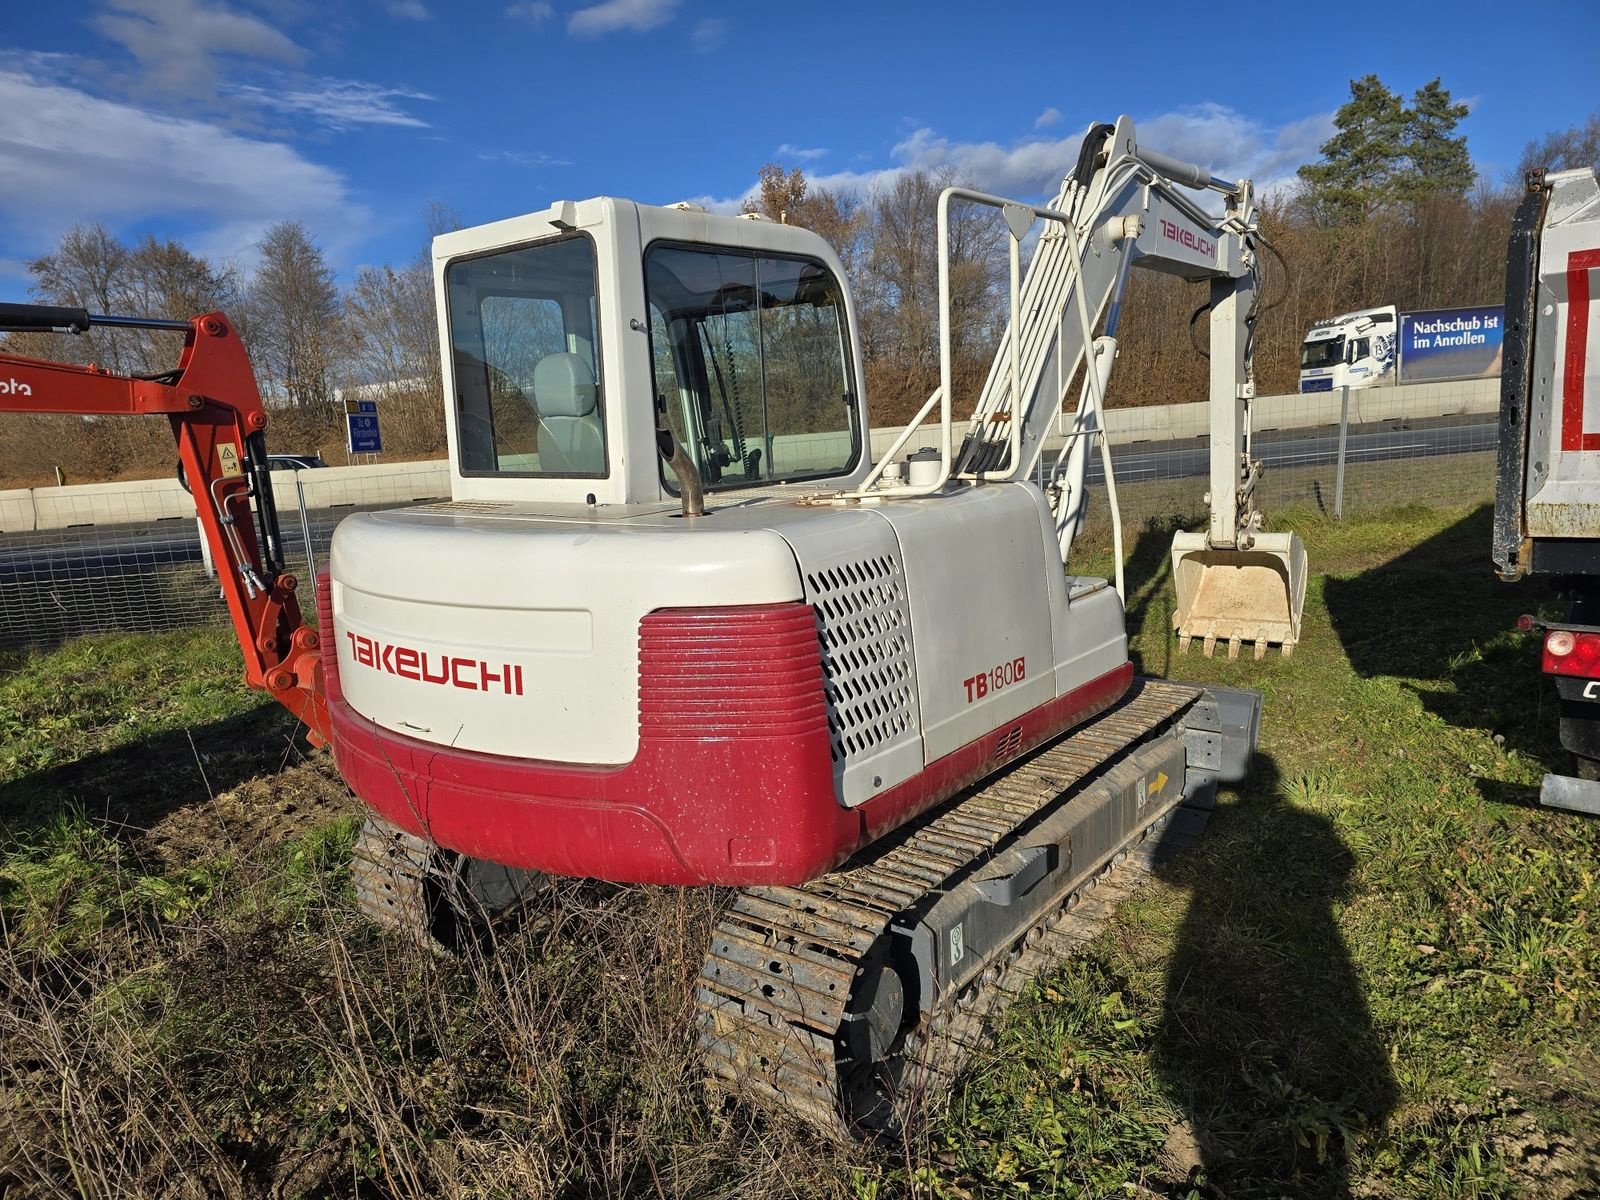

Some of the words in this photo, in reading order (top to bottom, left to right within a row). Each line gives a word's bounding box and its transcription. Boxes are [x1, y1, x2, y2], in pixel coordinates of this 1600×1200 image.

[1414, 316, 1480, 334] Nachschub
[1484, 316, 1498, 328] ist
[1414, 336, 1430, 349] im
[1433, 332, 1485, 347] Anrollen
